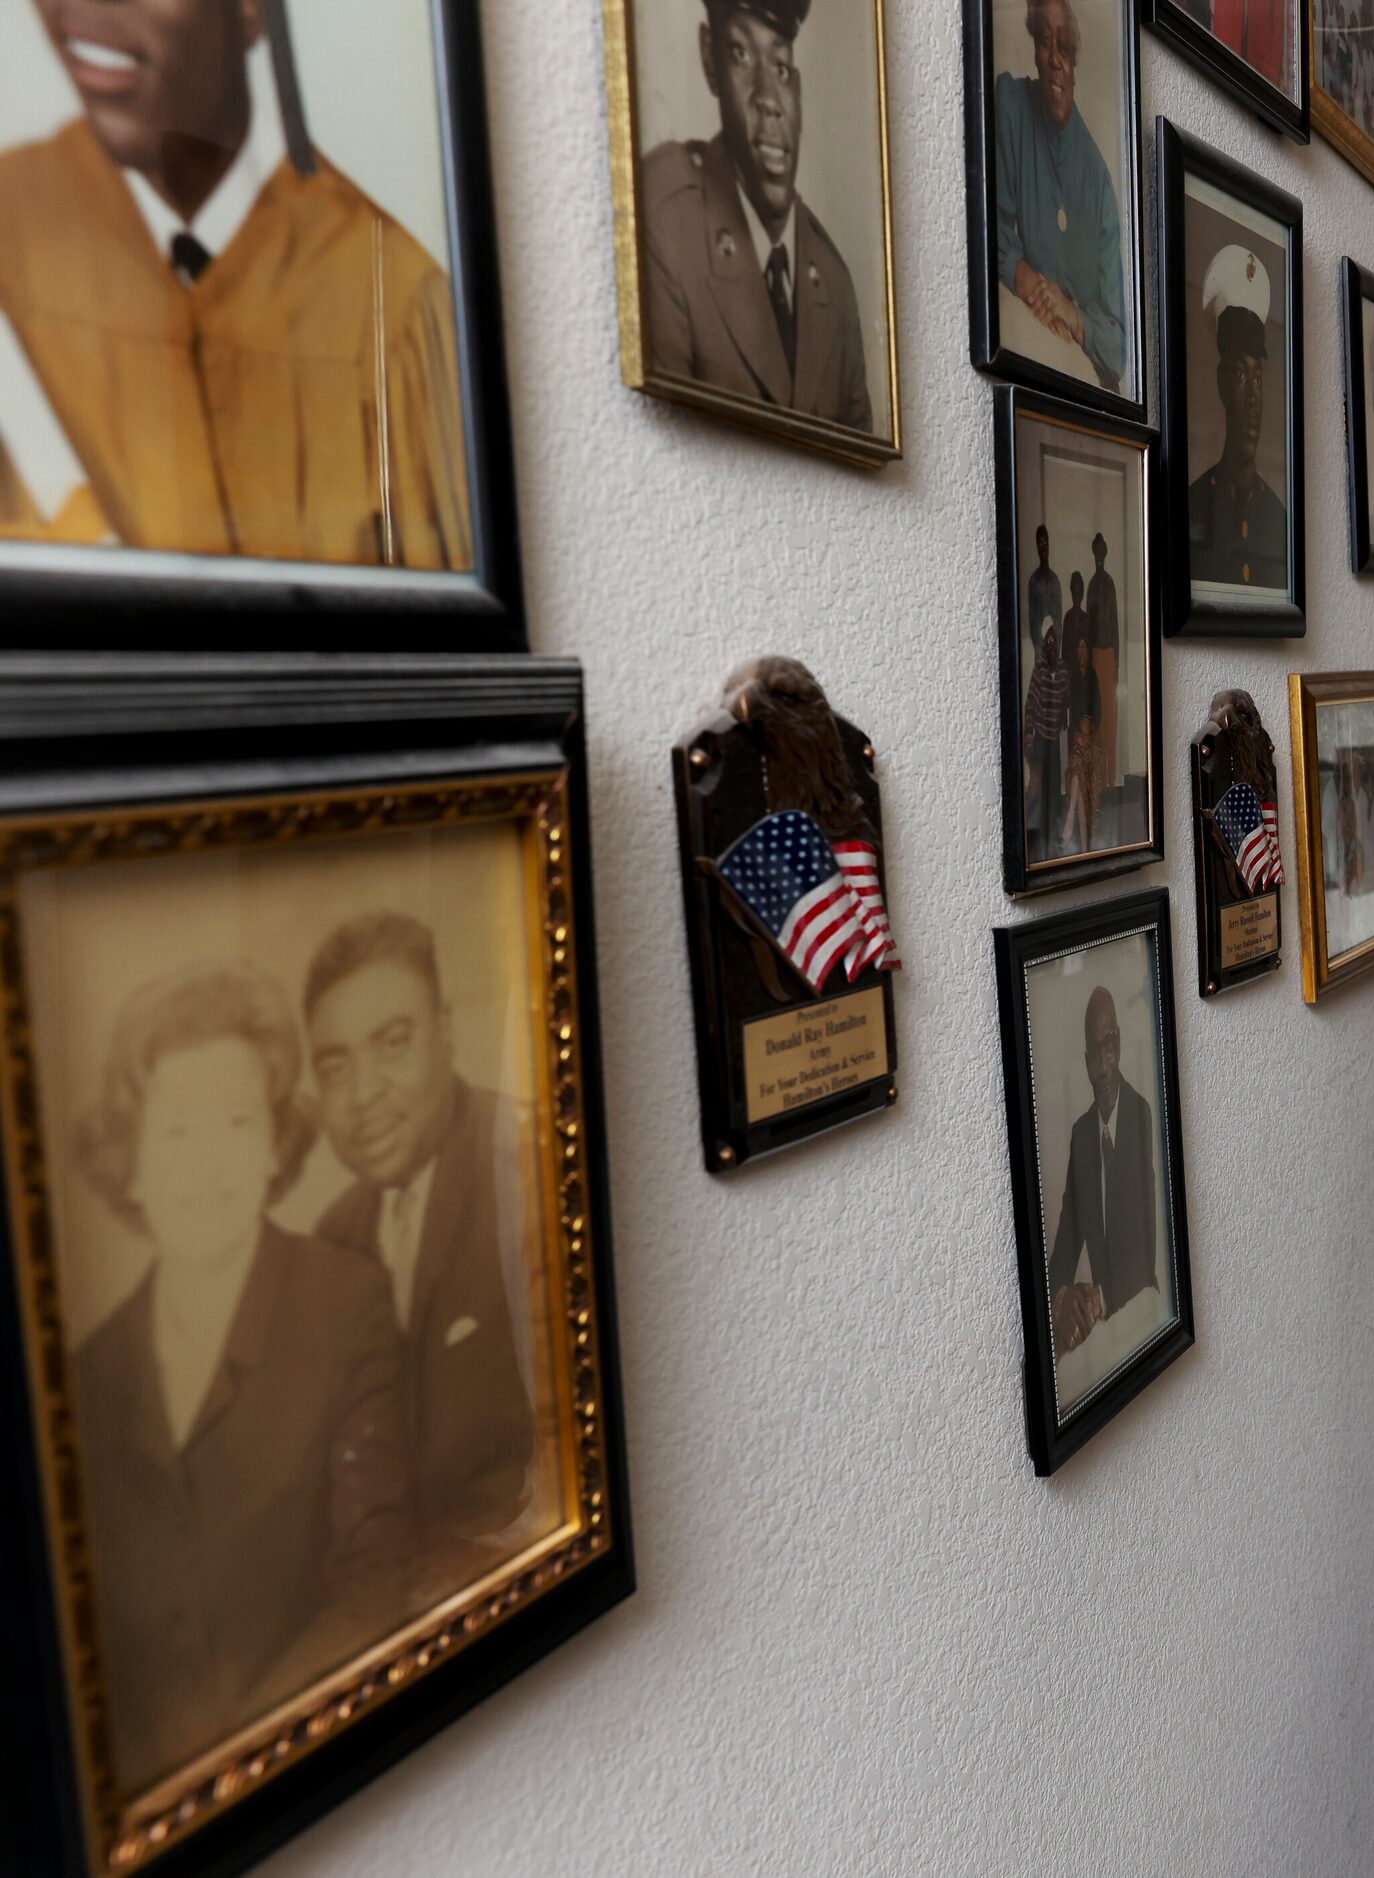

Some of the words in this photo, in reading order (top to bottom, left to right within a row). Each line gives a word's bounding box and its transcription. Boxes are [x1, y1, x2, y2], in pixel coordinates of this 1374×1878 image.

[1240, 912, 1254, 926] Russell
[765, 1031, 802, 1056] Donald
[804, 1028, 823, 1045] Ray
[825, 1015, 867, 1037] Hamilton
[809, 1046, 831, 1061] Army
[760, 1083, 775, 1098] For
[778, 1077, 798, 1091] Your
[799, 1062, 840, 1084] Dedication
[841, 1056, 849, 1070] &
[850, 1050, 876, 1065] Service
[782, 1081, 830, 1108] Hamilton's
[831, 1073, 859, 1090] Heroes
